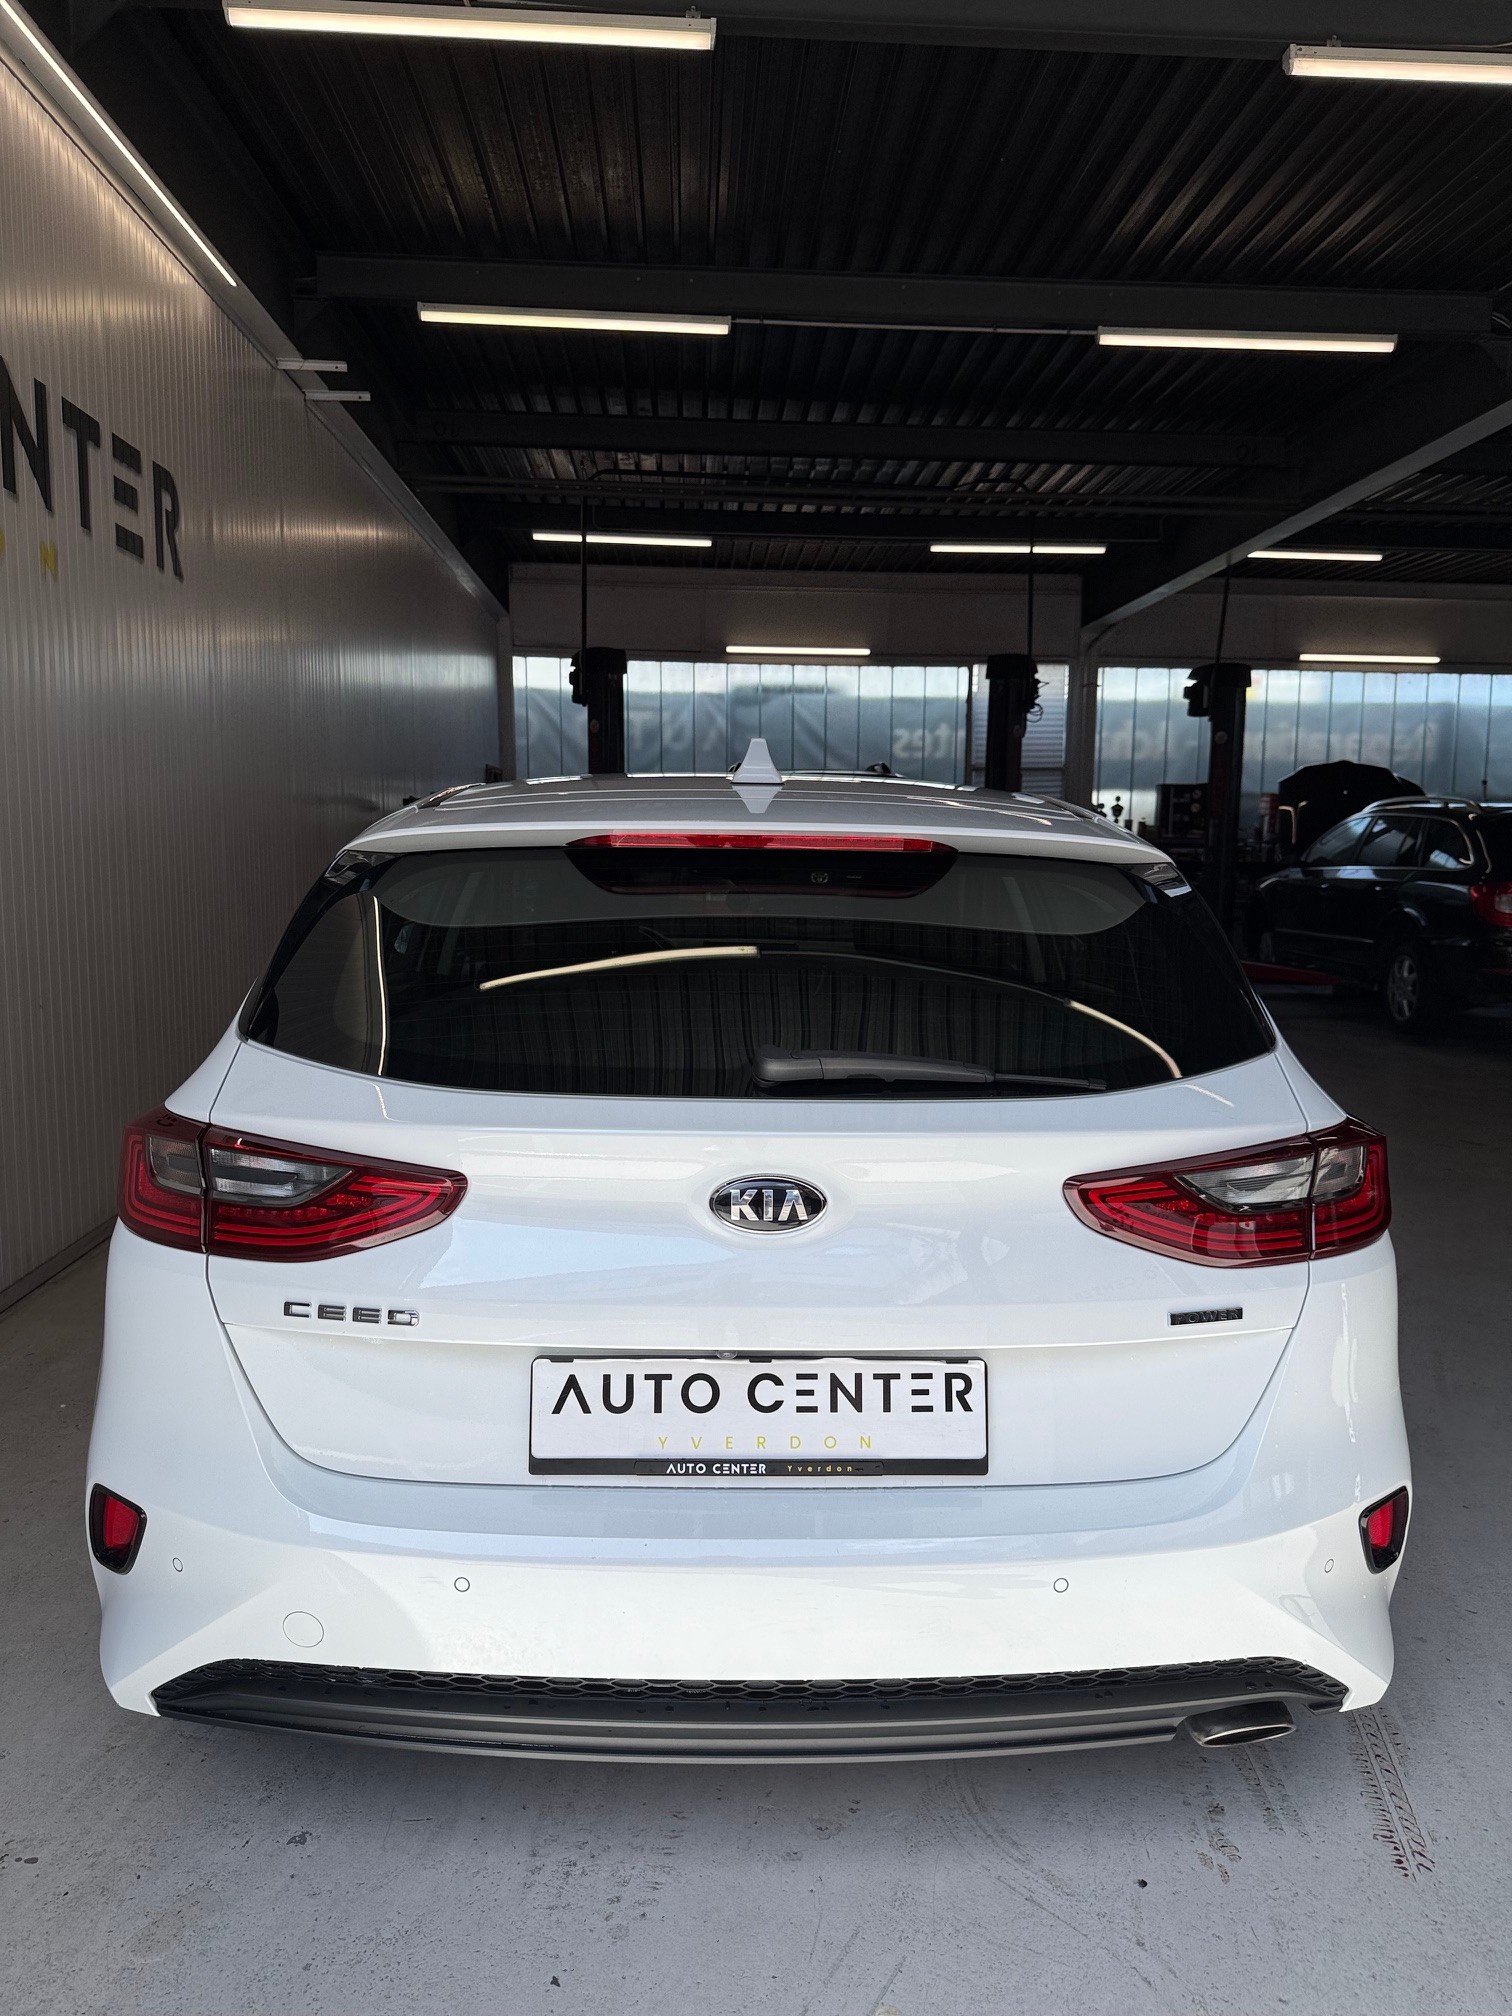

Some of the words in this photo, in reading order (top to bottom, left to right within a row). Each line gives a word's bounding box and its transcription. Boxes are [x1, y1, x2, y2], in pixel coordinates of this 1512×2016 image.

[730, 1189, 808, 1221] KIA
[283, 1301, 420, 1327] CEED
[1174, 1309, 1240, 1325] POWER
[551, 1372, 721, 1415] AUTO
[747, 1372, 973, 1415] CENTER
[658, 1436, 872, 1449] YVERDON
[666, 1463, 707, 1475] AUTO
[712, 1463, 767, 1475] CENTER
[787, 1464, 853, 1473] Yverdon
